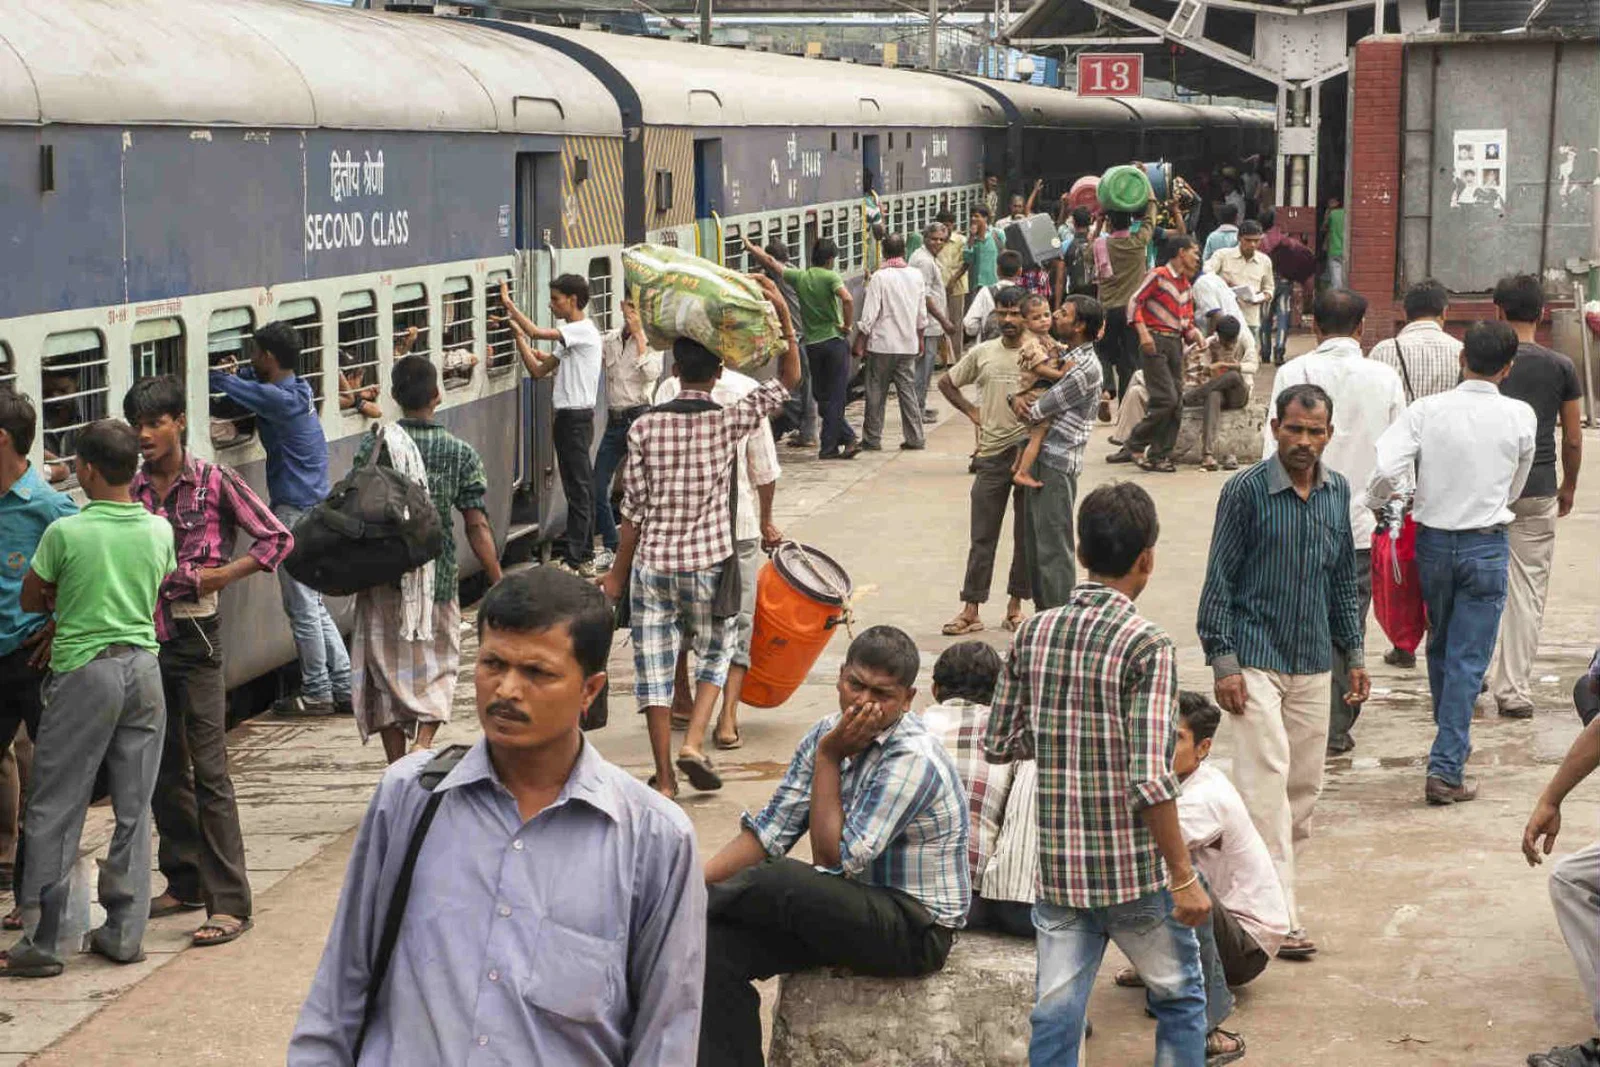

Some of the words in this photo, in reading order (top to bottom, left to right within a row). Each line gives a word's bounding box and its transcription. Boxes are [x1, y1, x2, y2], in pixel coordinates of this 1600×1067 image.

[1090, 61, 1130, 91] 13
[330, 150, 360, 202] द्वितीय
[363, 150, 384, 196] श्रेणी
[306, 212, 364, 251] SECOND
[371, 210, 409, 247] CLASS
